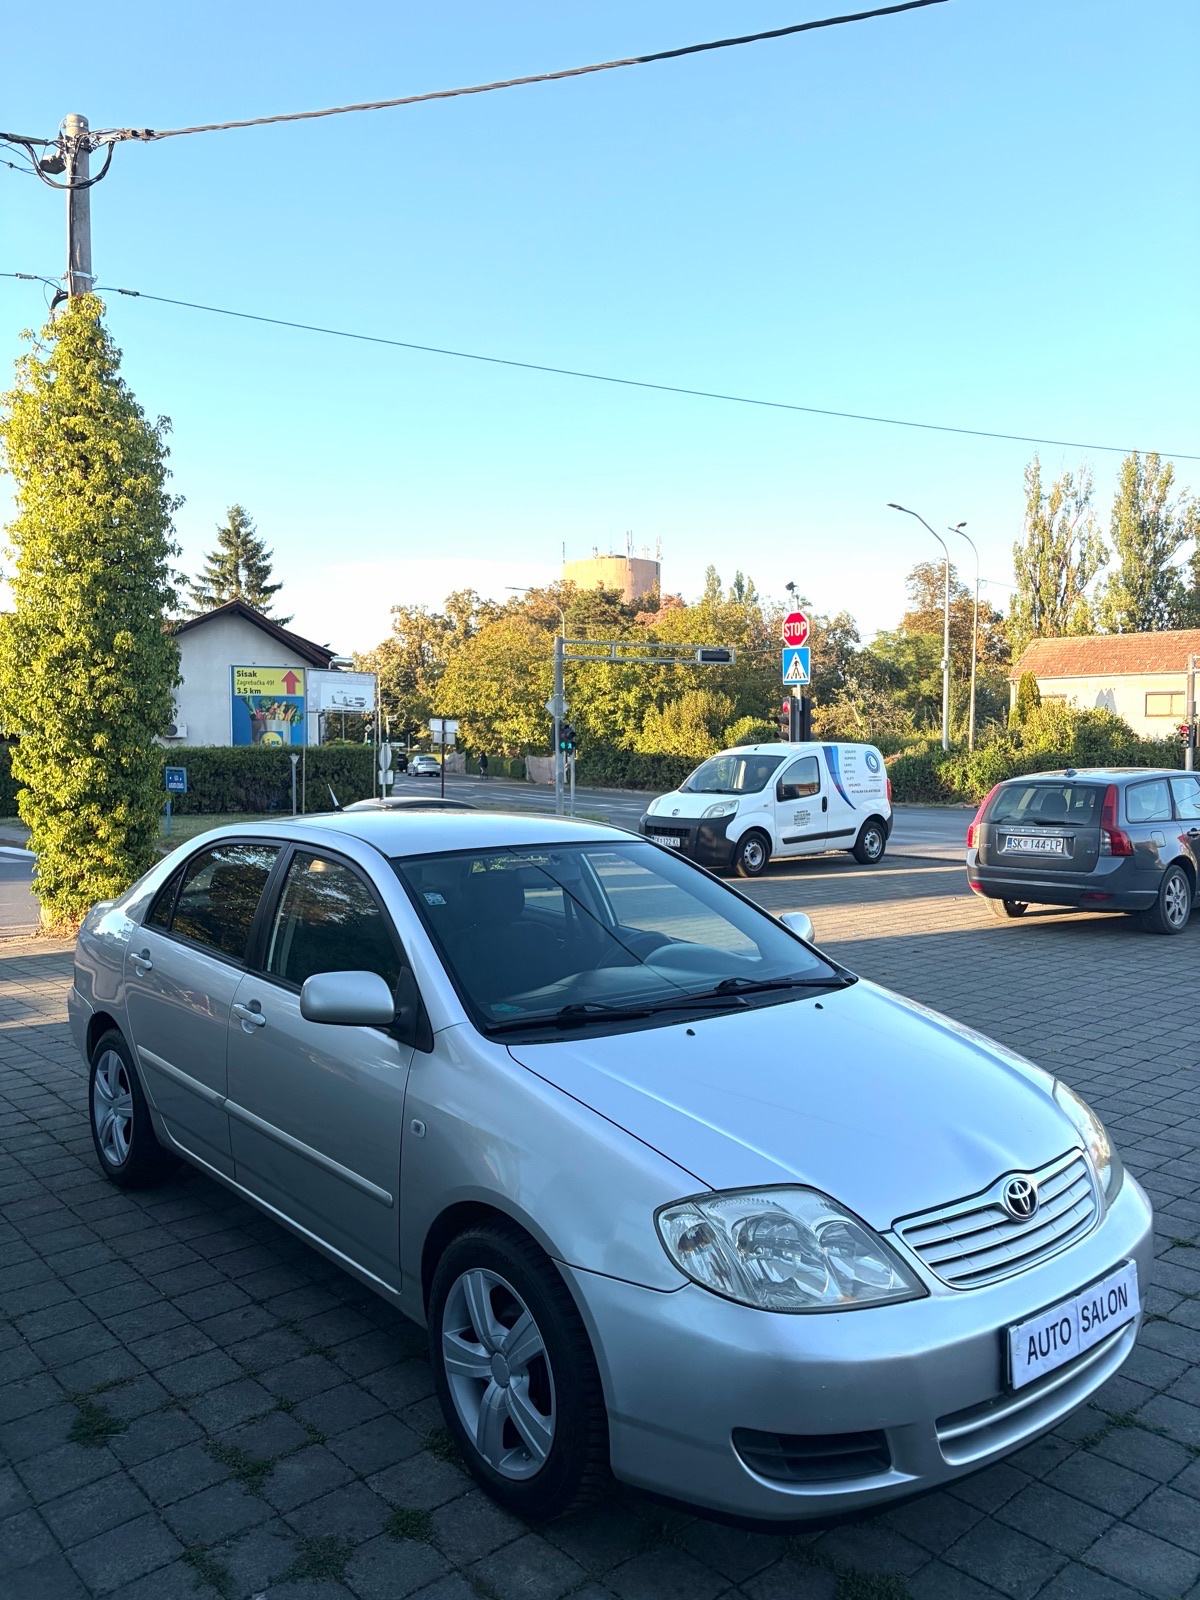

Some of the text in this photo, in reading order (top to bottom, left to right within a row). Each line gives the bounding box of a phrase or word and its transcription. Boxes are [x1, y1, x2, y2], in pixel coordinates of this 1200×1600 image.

[784, 621, 807, 637] STOP
[236, 670, 257, 678] Sisak
[1012, 838, 1062, 851] SK 144-LP
[1027, 1282, 1128, 1365] AUTO SALON
